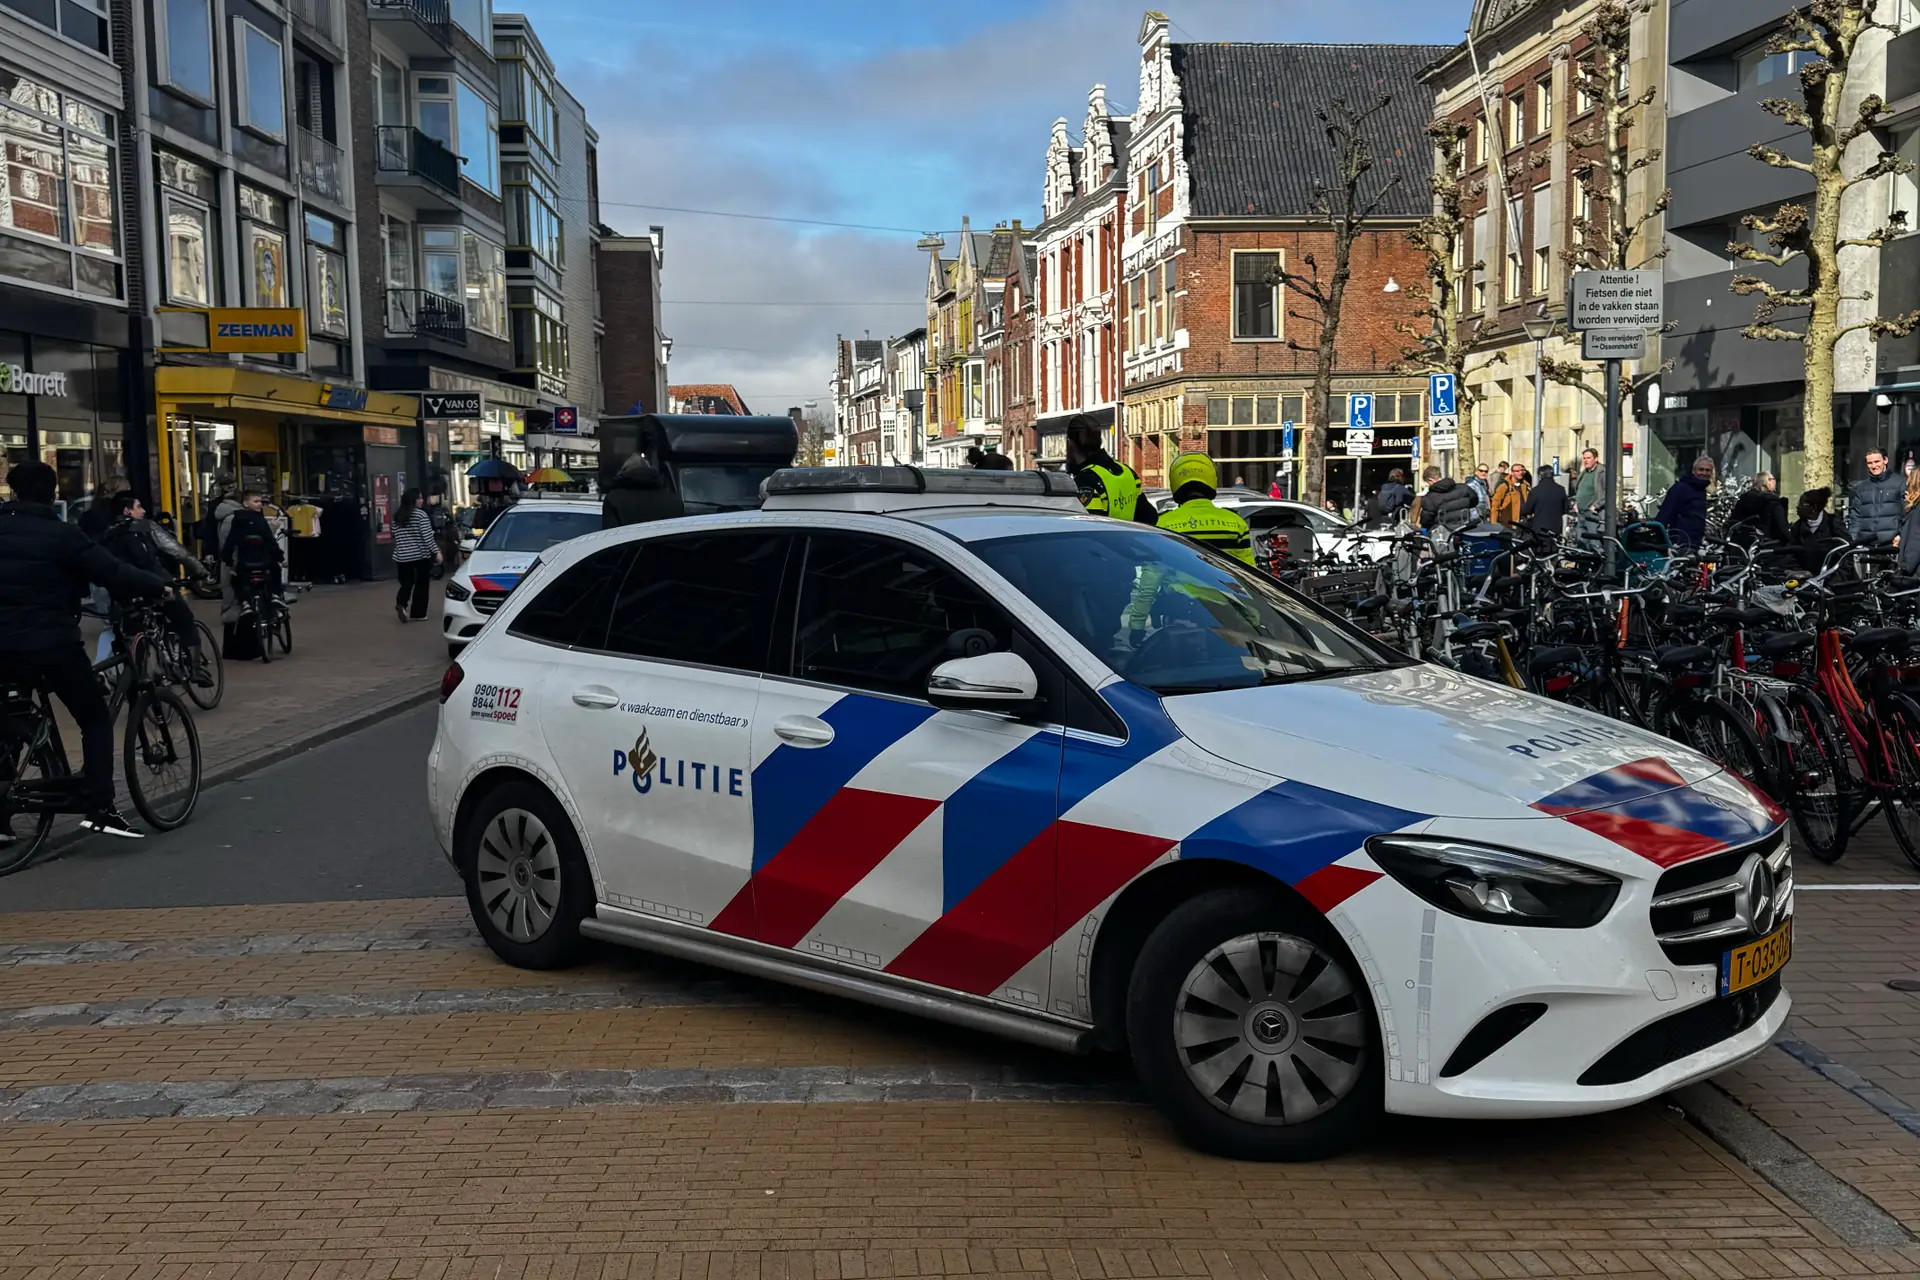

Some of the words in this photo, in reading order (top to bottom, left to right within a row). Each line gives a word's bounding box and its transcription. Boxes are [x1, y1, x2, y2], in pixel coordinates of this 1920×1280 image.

[1599, 275, 1634, 284] Attentie
[1586, 288, 1618, 298] Fietsen
[1620, 288, 1634, 297] die
[1635, 288, 1653, 297] niet
[1578, 301, 1587, 311] in
[1589, 301, 1600, 311] de
[1602, 301, 1632, 310] vakken
[1634, 302, 1659, 310] staan
[1578, 315, 1611, 324] worden
[1613, 314, 1660, 325] verwijderd
[217, 323, 294, 337] ZEEMAN
[1591, 334, 1607, 342] Fiets
[11, 364, 68, 397] Barrett
[444, 400, 465, 409] VAN
[466, 400, 479, 409] OS
[1382, 438, 1414, 447] BEANS
[475, 684, 498, 697] 0900
[472, 696, 494, 710] 8844
[498, 687, 521, 709] 112
[493, 710, 518, 722] spoed
[676, 709, 689, 719] en
[1506, 727, 1628, 759] POLITIE
[612, 749, 744, 797] POLITIE
